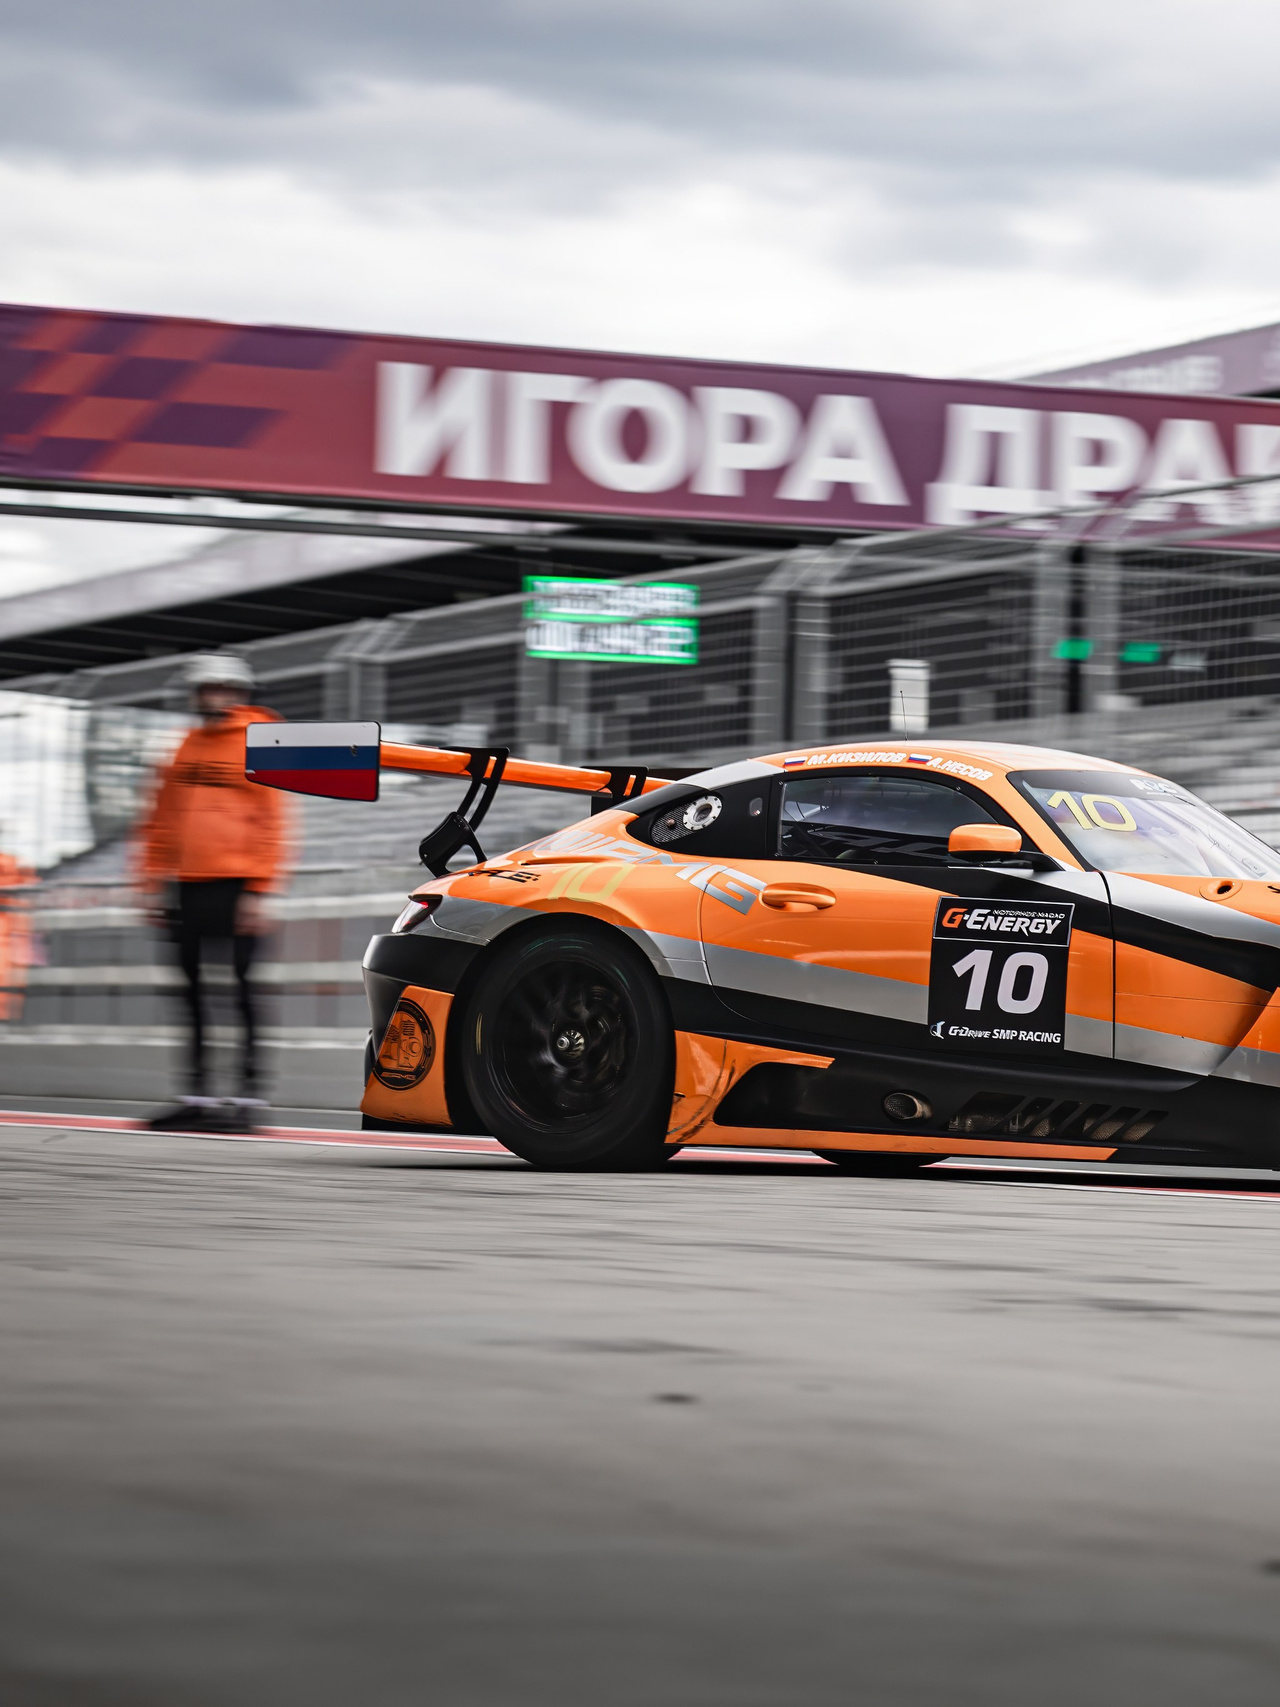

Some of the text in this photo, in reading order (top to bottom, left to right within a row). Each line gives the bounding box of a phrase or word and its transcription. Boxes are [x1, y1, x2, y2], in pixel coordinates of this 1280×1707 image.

[373, 361, 911, 507] ИГОРА
[1047, 791, 1138, 832] 10
[548, 862, 636, 902] 10
[952, 949, 1049, 1014] 10
[992, 1028, 1017, 1040] SMP
[1018, 1030, 1061, 1043] RACING
